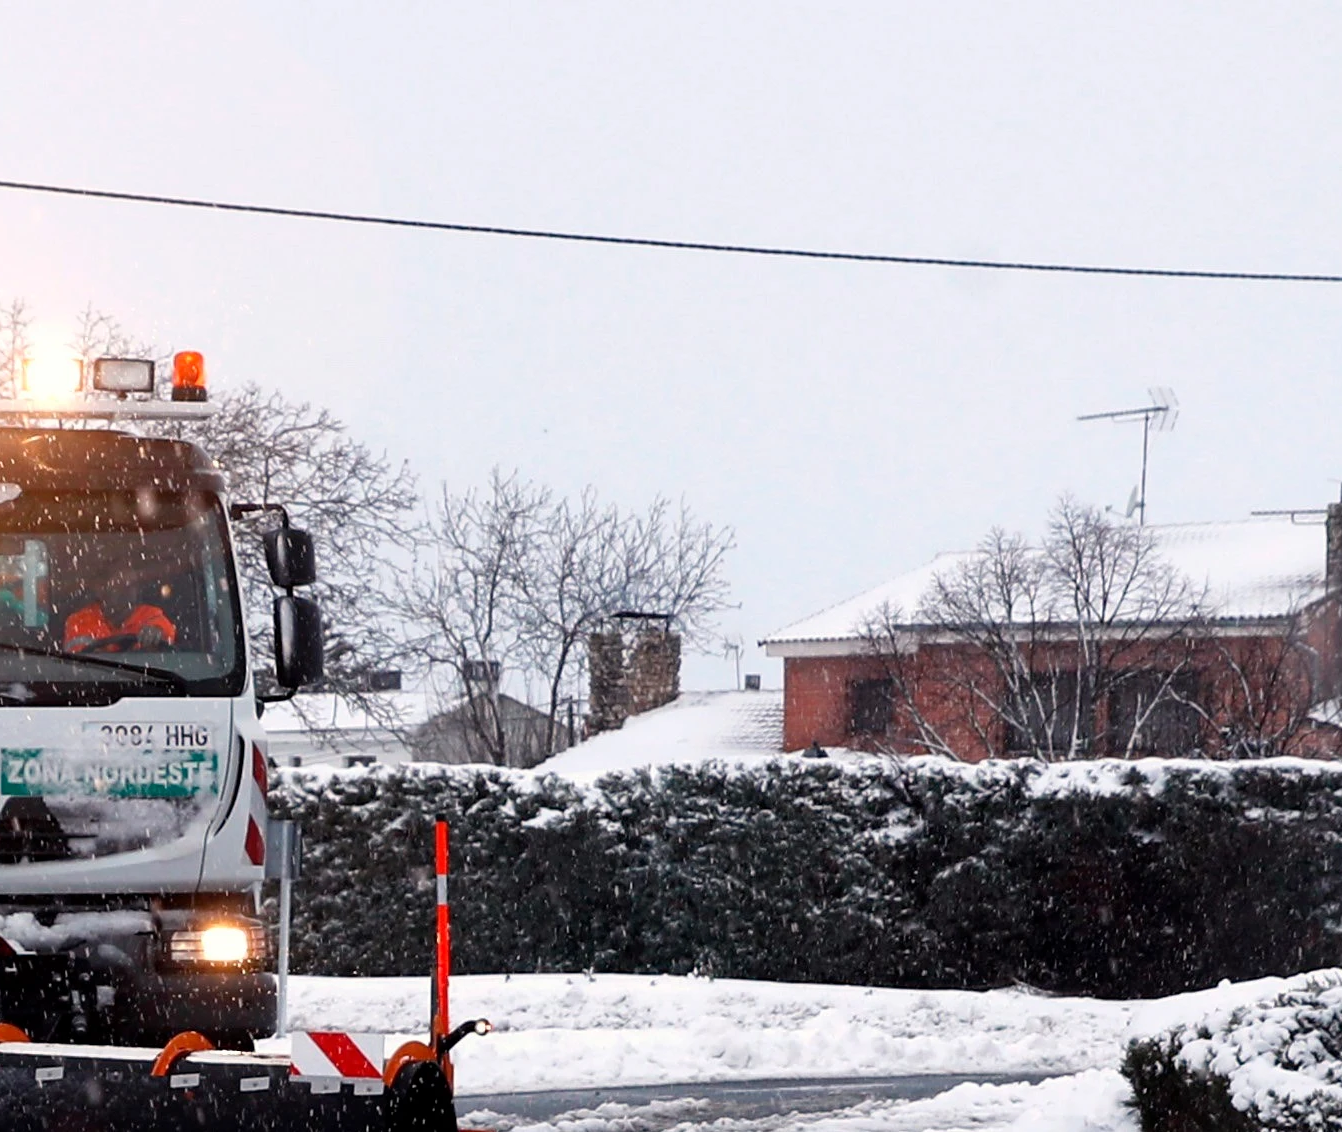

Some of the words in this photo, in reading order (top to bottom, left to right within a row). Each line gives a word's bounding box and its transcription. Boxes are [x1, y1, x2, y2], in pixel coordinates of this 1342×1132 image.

[166, 724, 208, 746] HHG
[8, 760, 77, 784] ZONA
[86, 762, 212, 784] NORDESTE
